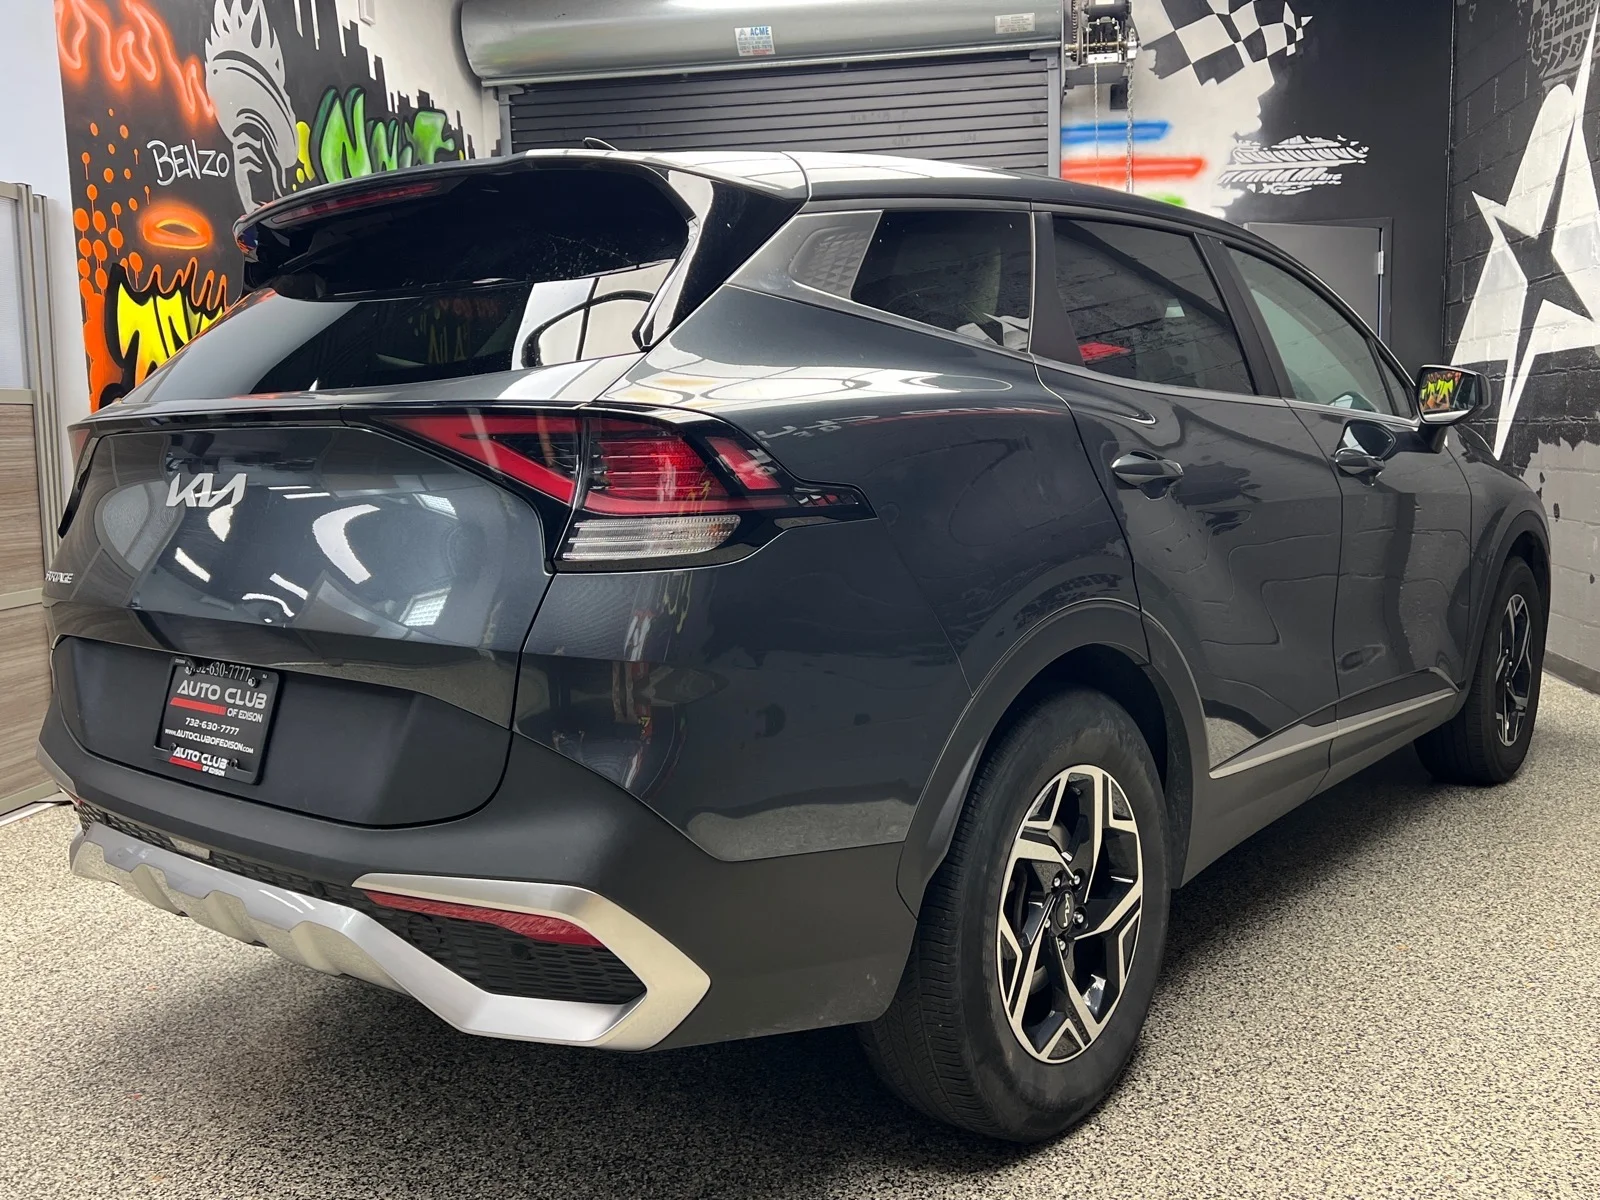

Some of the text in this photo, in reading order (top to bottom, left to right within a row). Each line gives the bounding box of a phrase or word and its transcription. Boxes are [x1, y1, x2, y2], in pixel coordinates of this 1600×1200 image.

[750, 27, 769, 36] ACME
[145, 138, 231, 186] BENZO
[165, 472, 247, 508] KIA
[177, 679, 267, 709] AUTO CLUB
[227, 708, 263, 723] OF EDISON
[184, 717, 240, 736] 732-630-7777
[172, 745, 228, 769] AUTO CLUB
[208, 766, 226, 777] EDISON
